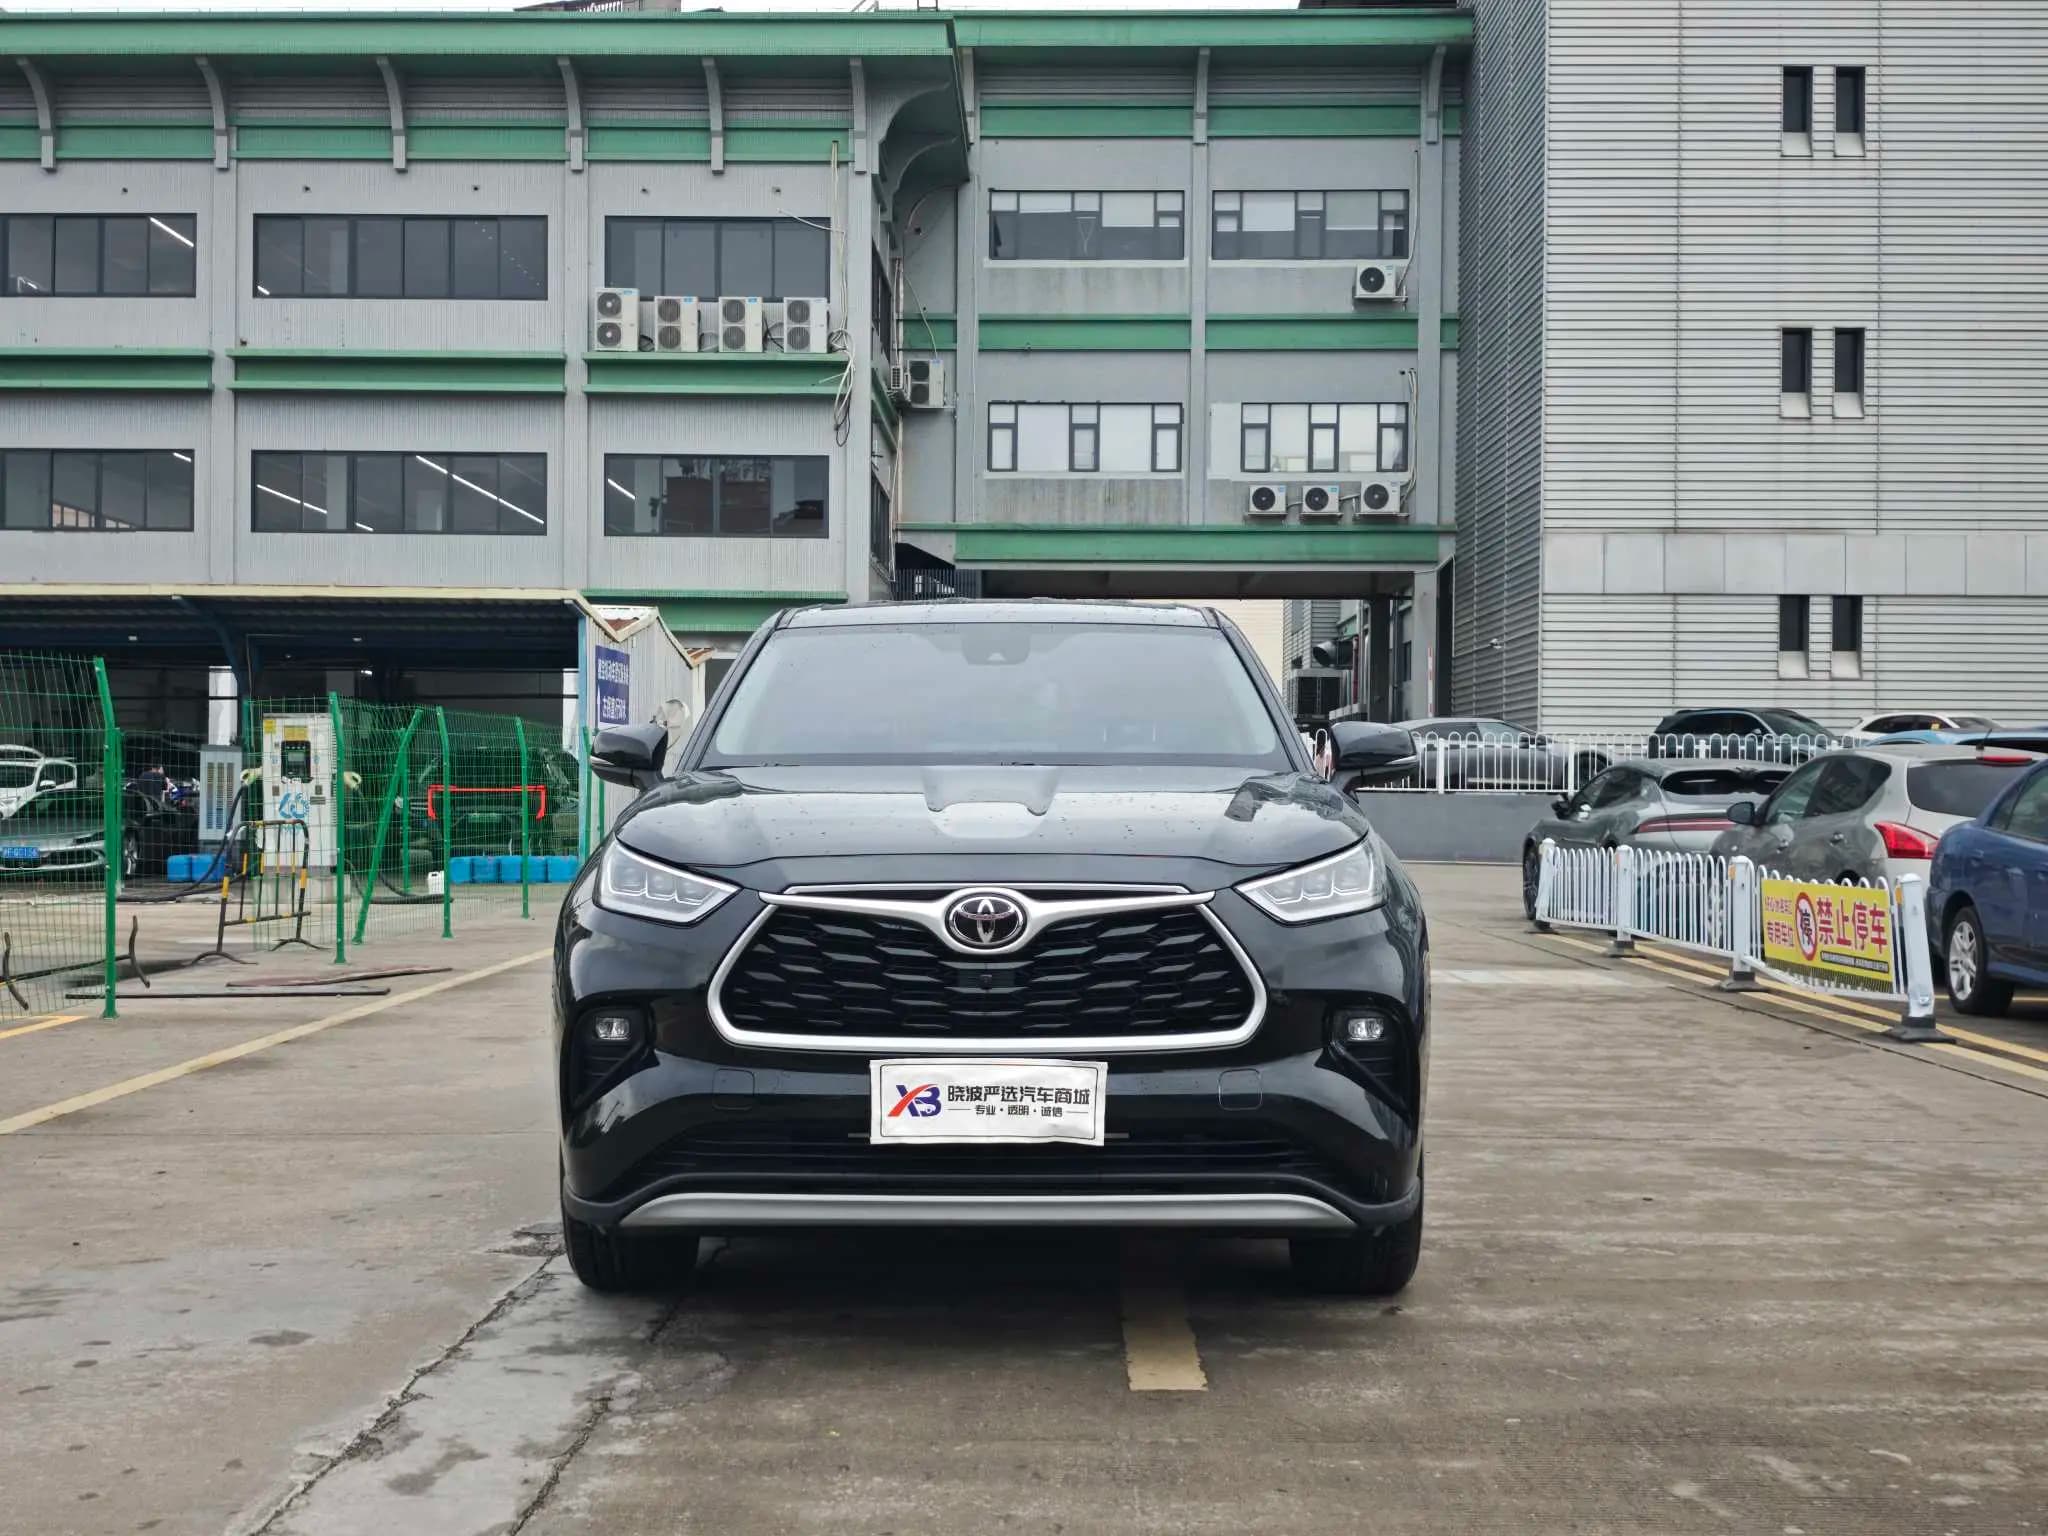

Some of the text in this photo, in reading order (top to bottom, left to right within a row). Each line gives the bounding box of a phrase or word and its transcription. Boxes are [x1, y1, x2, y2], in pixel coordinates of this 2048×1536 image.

[1816, 896, 1888, 954] 禁止停车
[947, 1085, 1091, 1105] 晓波严选汽车商城
